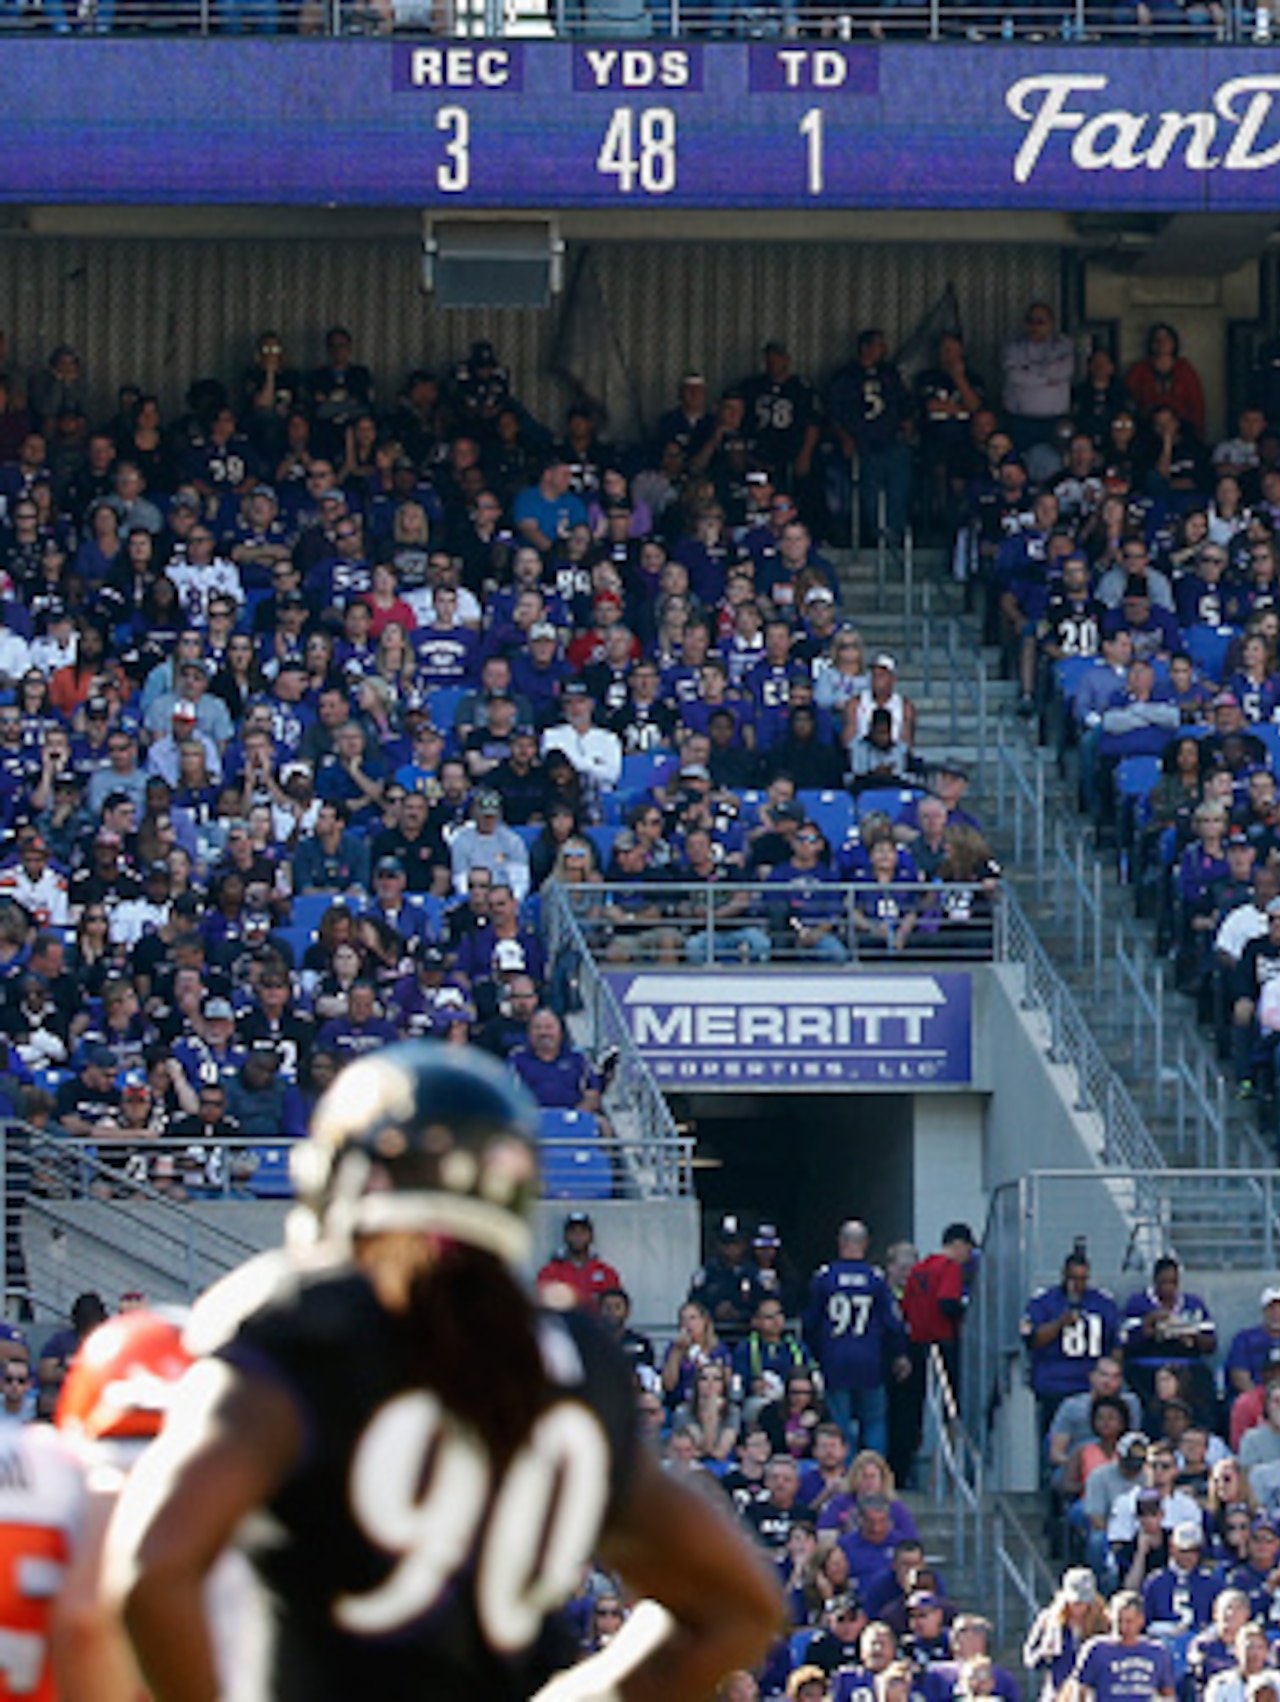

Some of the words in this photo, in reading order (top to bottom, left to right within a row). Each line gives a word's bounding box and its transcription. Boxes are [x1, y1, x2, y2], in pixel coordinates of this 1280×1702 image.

[412, 50, 510, 86] REC
[587, 50, 690, 86] YDS
[776, 50, 847, 86] TD
[436, 105, 470, 192] 3
[597, 106, 675, 192] 48
[799, 107, 823, 195] 1
[864, 381, 884, 421] 5
[1060, 618, 1099, 658] 20
[632, 1006, 935, 1045] MERRITT
[829, 1293, 874, 1335] 97
[1061, 1313, 1102, 1358] 81
[333, 1388, 610, 1652] 90
[1172, 1588, 1195, 1633] 5
